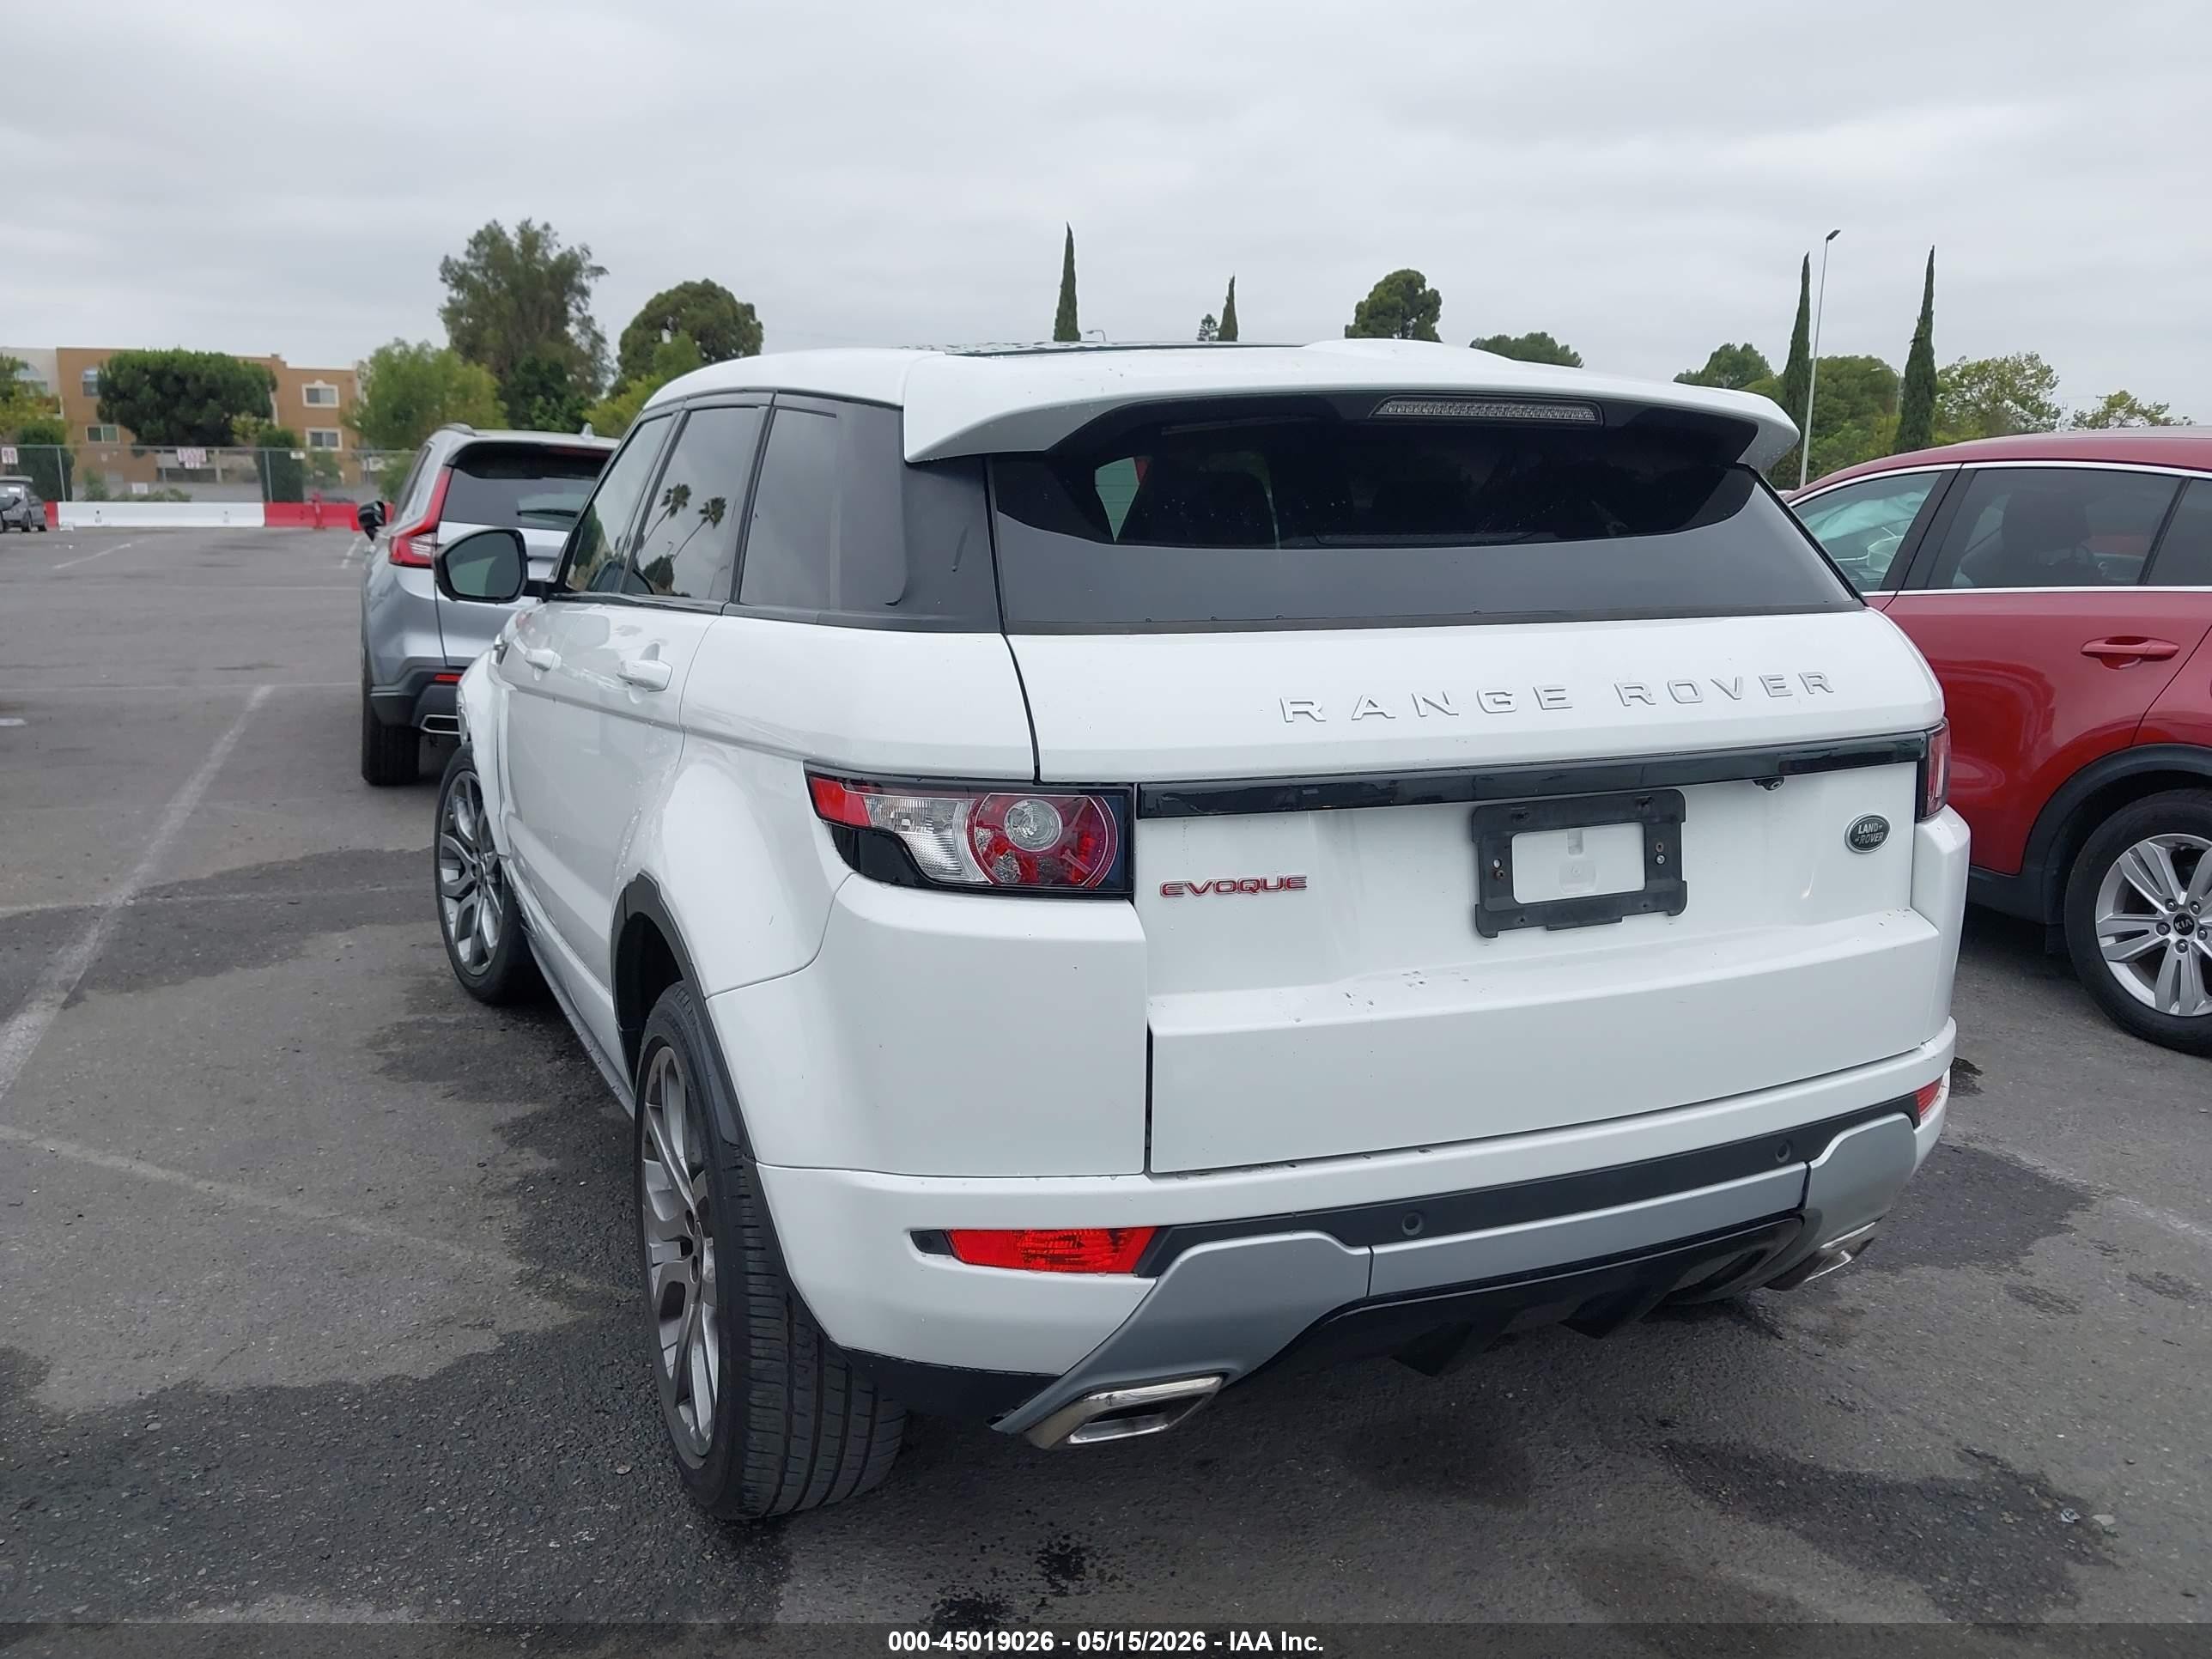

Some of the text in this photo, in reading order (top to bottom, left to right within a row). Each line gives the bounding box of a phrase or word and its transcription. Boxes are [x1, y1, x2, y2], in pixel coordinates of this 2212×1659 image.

[1279, 671, 1835, 722] RANGE ROVER
[1857, 823, 1879, 835] LAND
[1858, 831, 1884, 845] ROVER
[1160, 875, 1308, 897] EVOQUE
[2174, 919, 2194, 931] KIA
